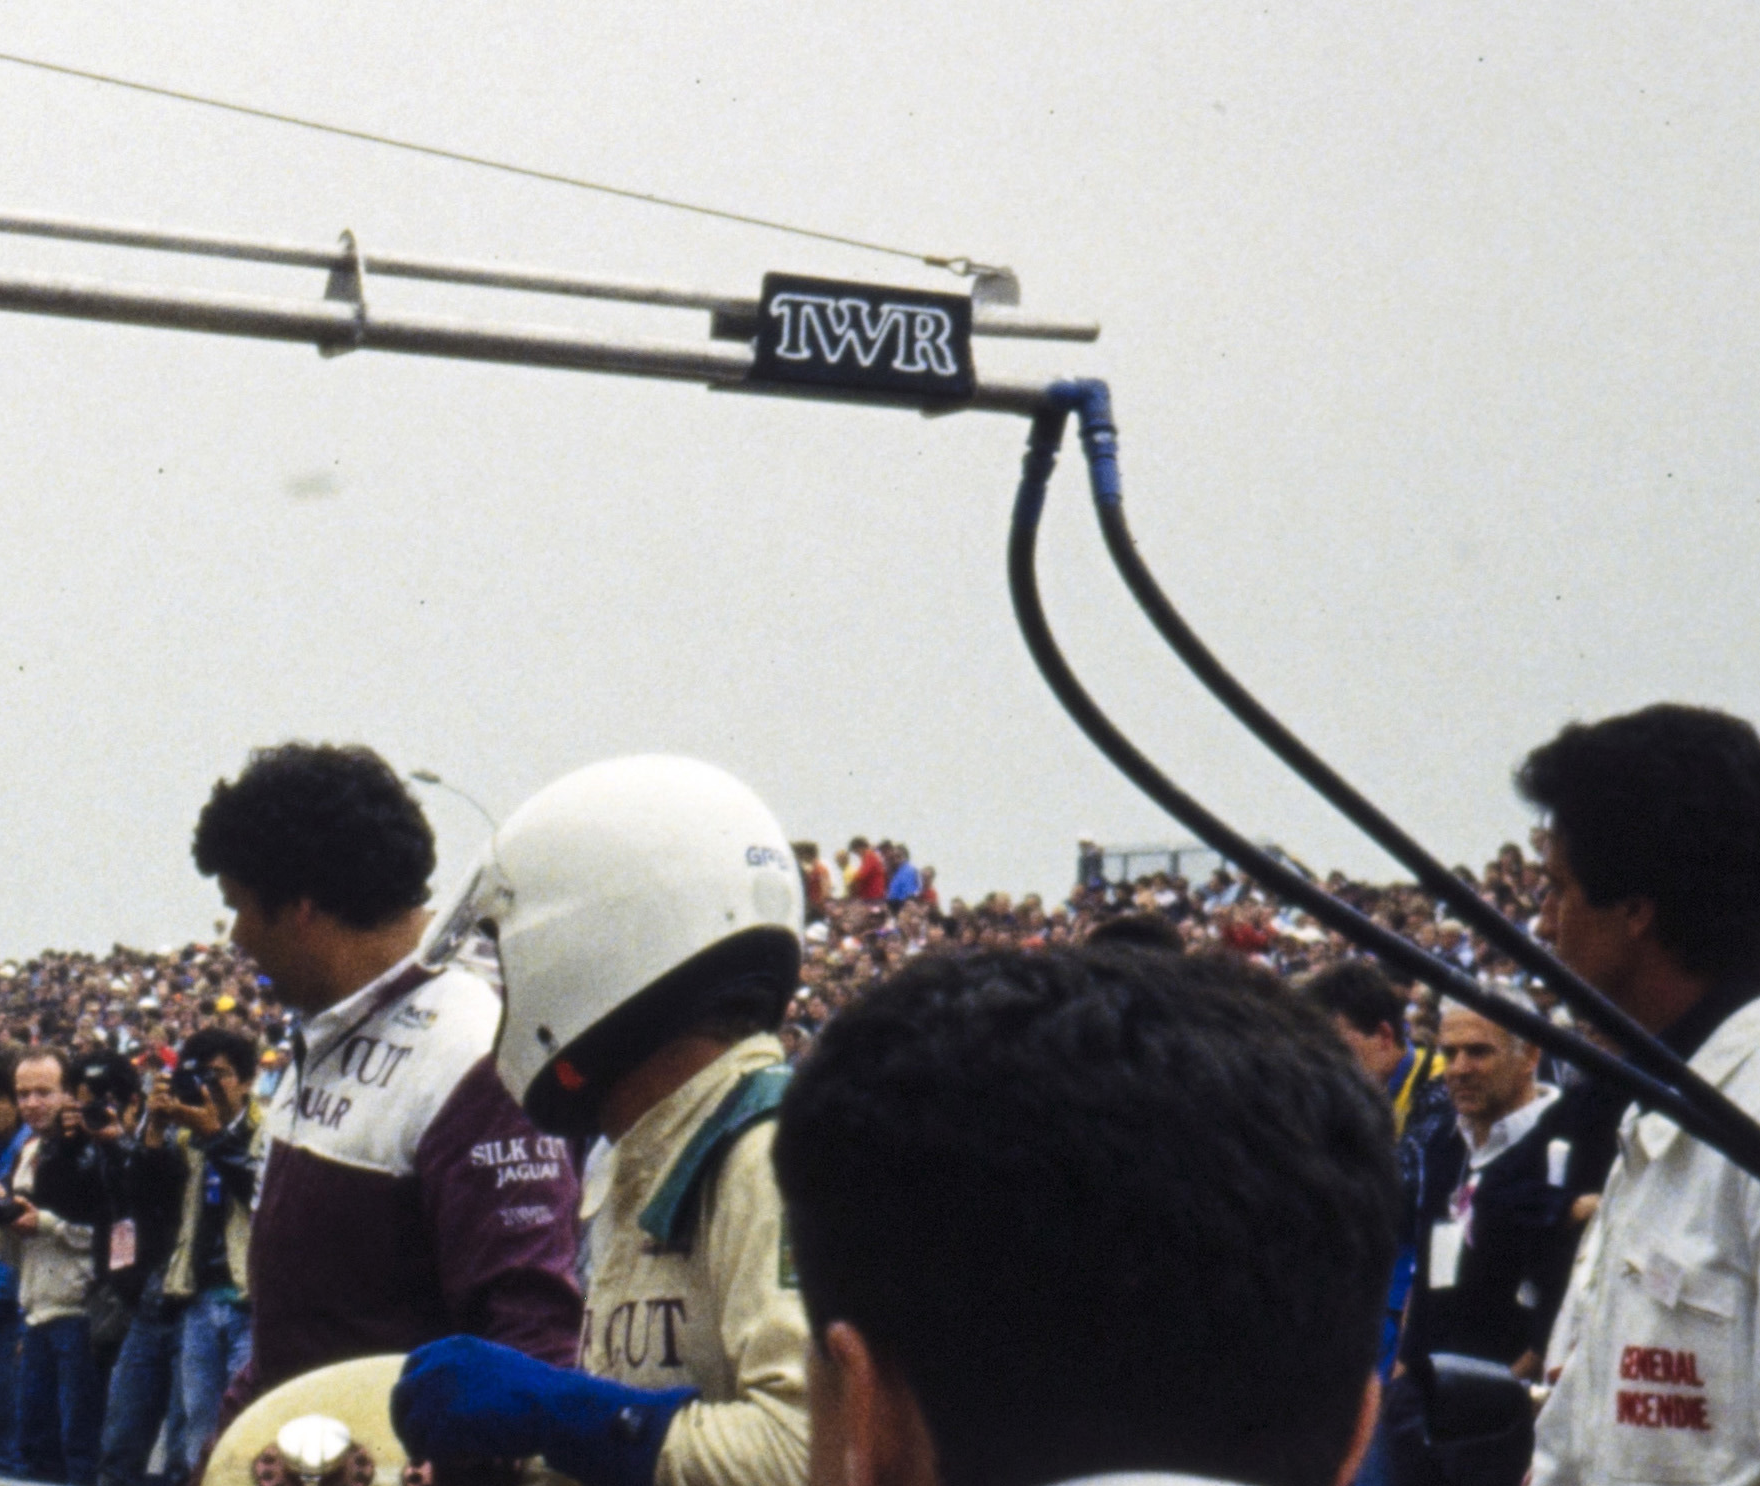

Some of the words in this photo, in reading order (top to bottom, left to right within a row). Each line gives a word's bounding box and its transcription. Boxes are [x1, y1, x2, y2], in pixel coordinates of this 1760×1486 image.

[770, 292, 957, 376] TWR
[470, 1137, 529, 1167] SILK
[604, 1297, 687, 1369] CUT
